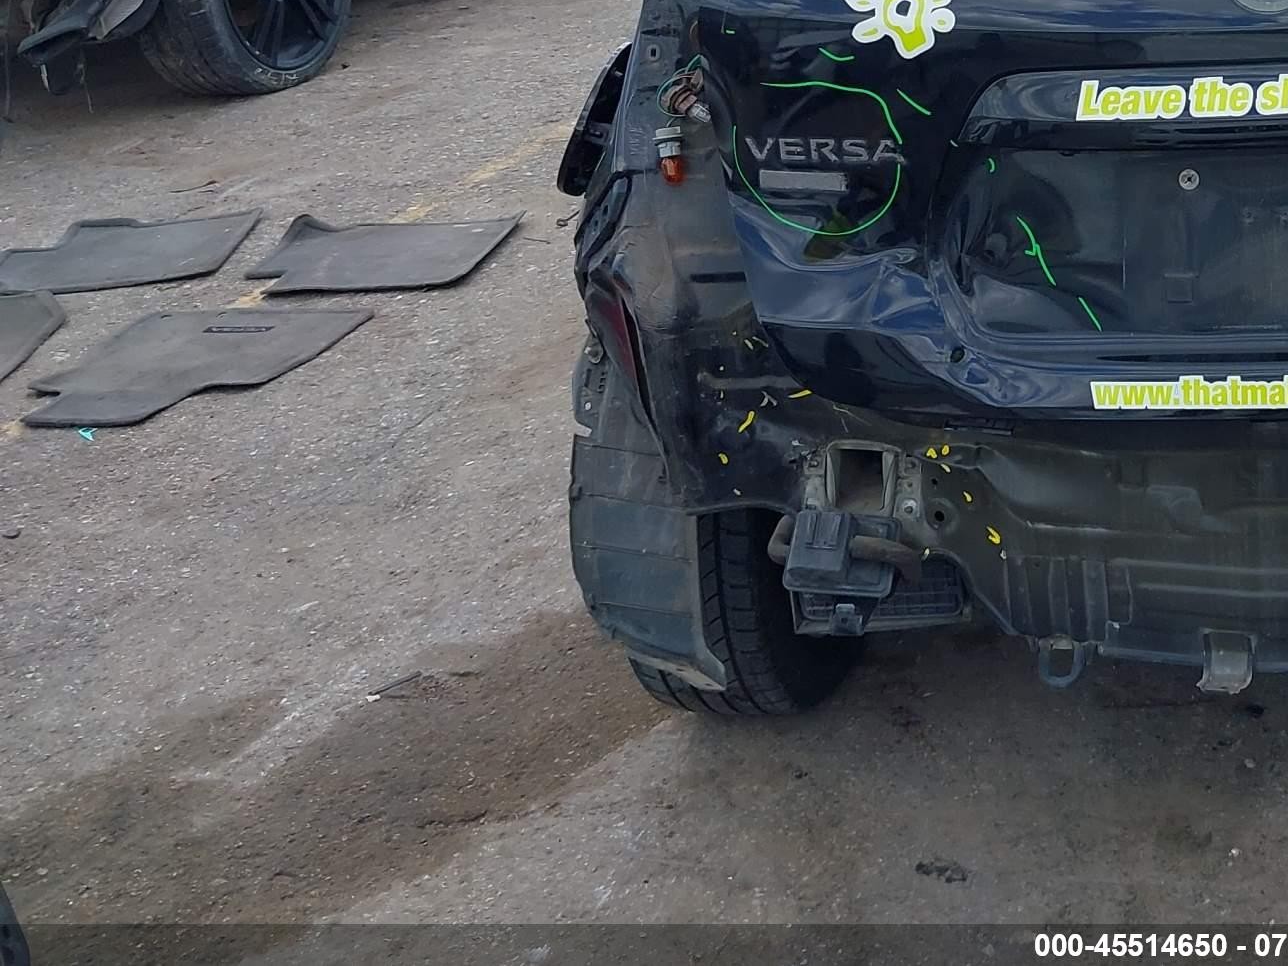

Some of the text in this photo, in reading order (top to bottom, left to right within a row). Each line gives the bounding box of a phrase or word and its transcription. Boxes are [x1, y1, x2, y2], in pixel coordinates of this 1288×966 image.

[1079, 81, 1183, 117] Leave
[1191, 78, 1251, 115] the
[744, 137, 905, 164] VERSA
